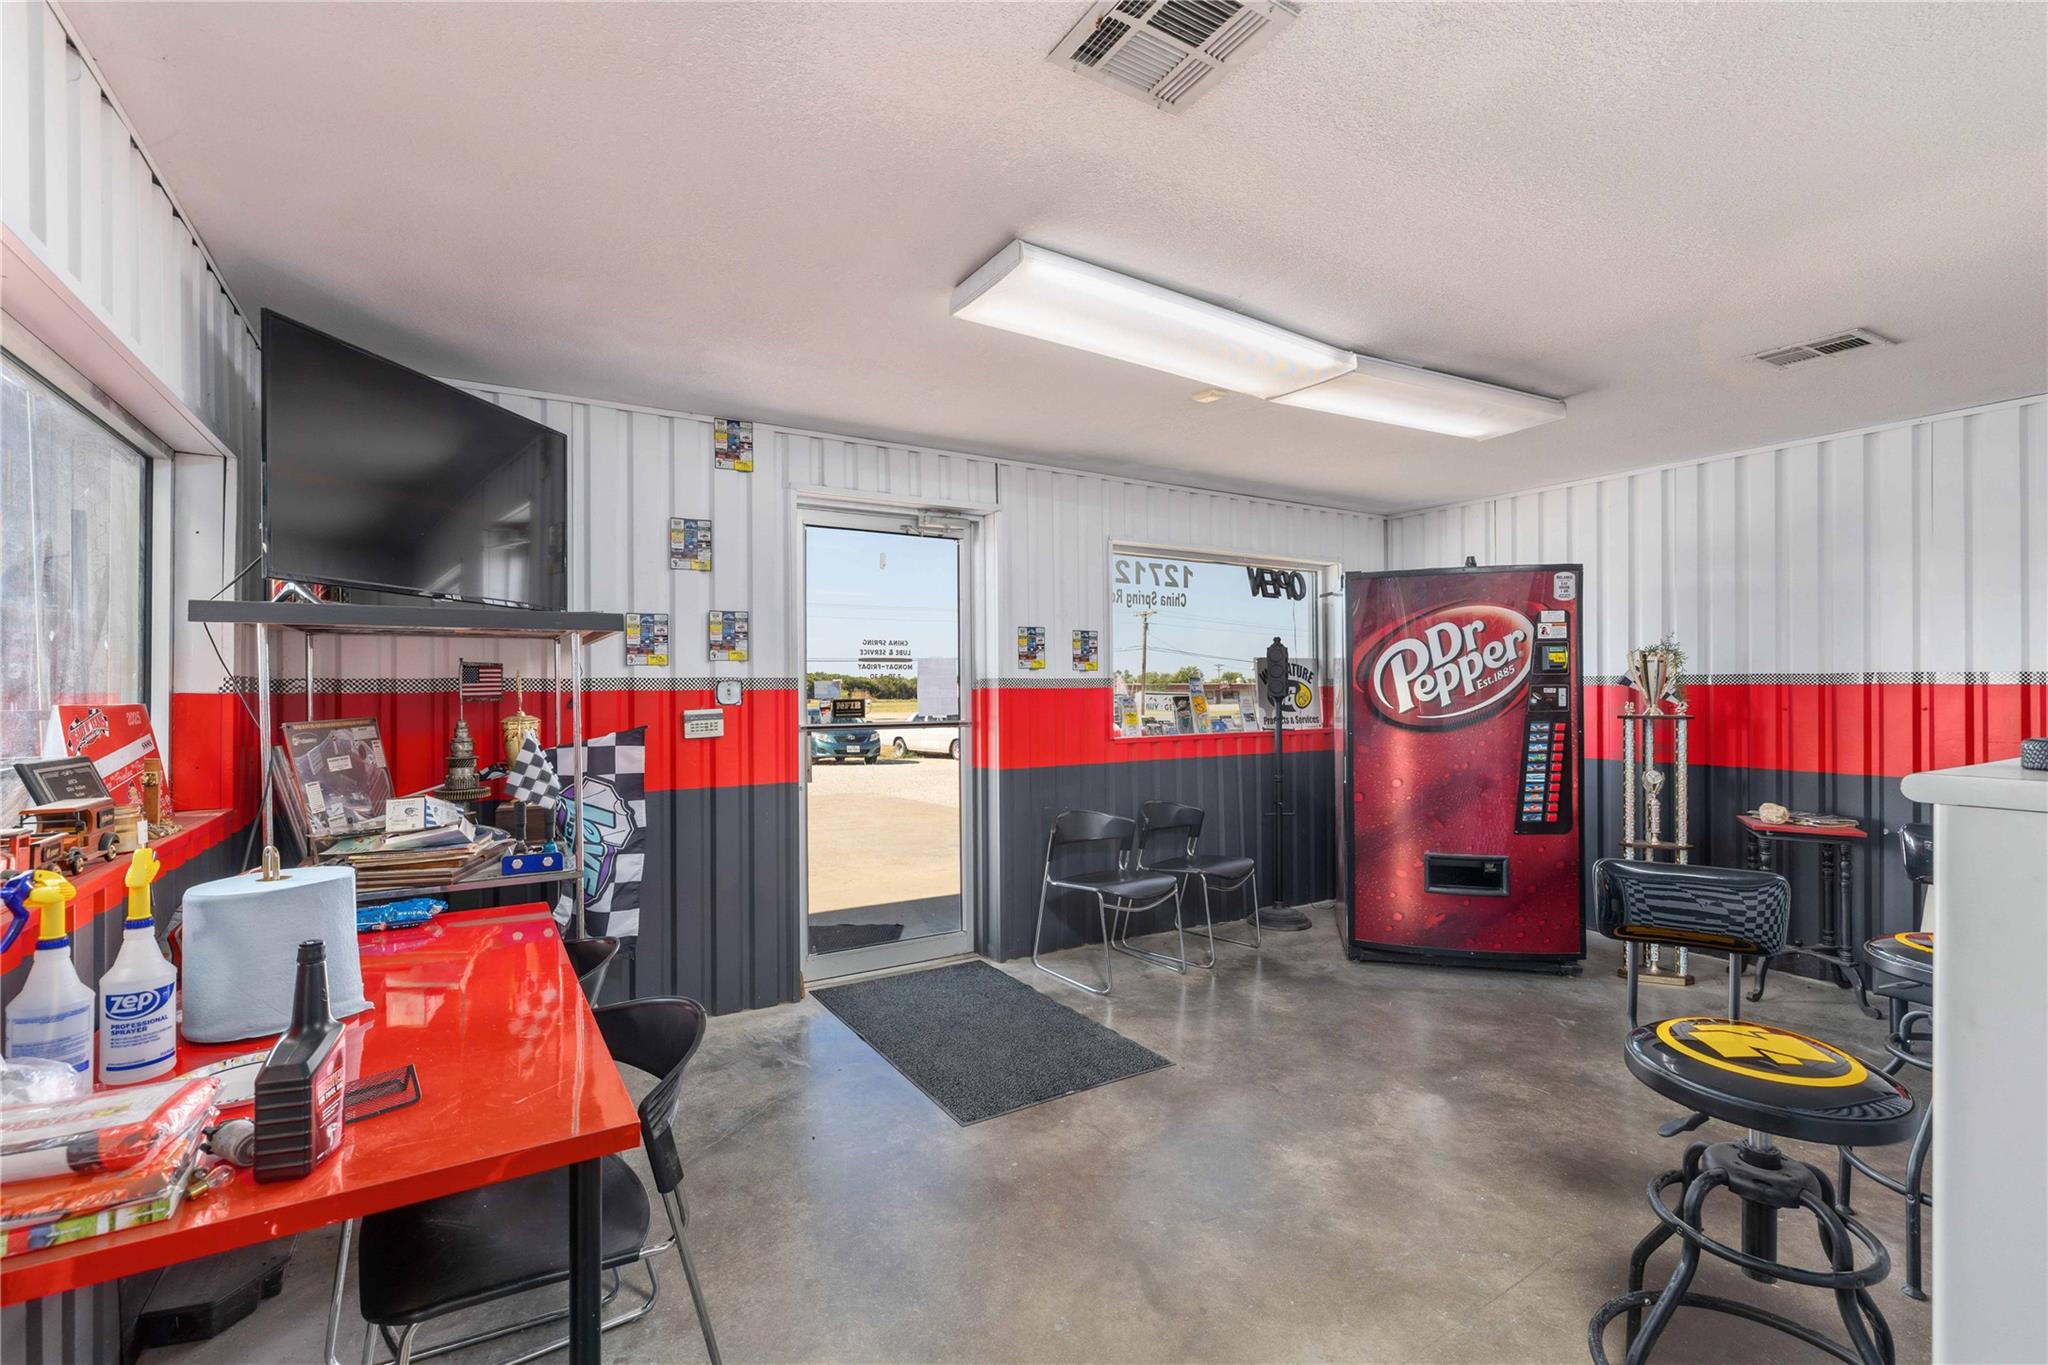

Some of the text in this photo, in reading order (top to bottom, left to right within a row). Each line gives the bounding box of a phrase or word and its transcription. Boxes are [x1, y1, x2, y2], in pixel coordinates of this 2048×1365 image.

[1424, 619, 1486, 669] Dr
[1373, 629, 1527, 714] Pepper
[1476, 665, 1516, 690] Est.1885
[1295, 714, 1321, 725] Services
[110, 1014, 168, 1031] PROFESSIONAL
[110, 1026, 148, 1036] SPRAYER
